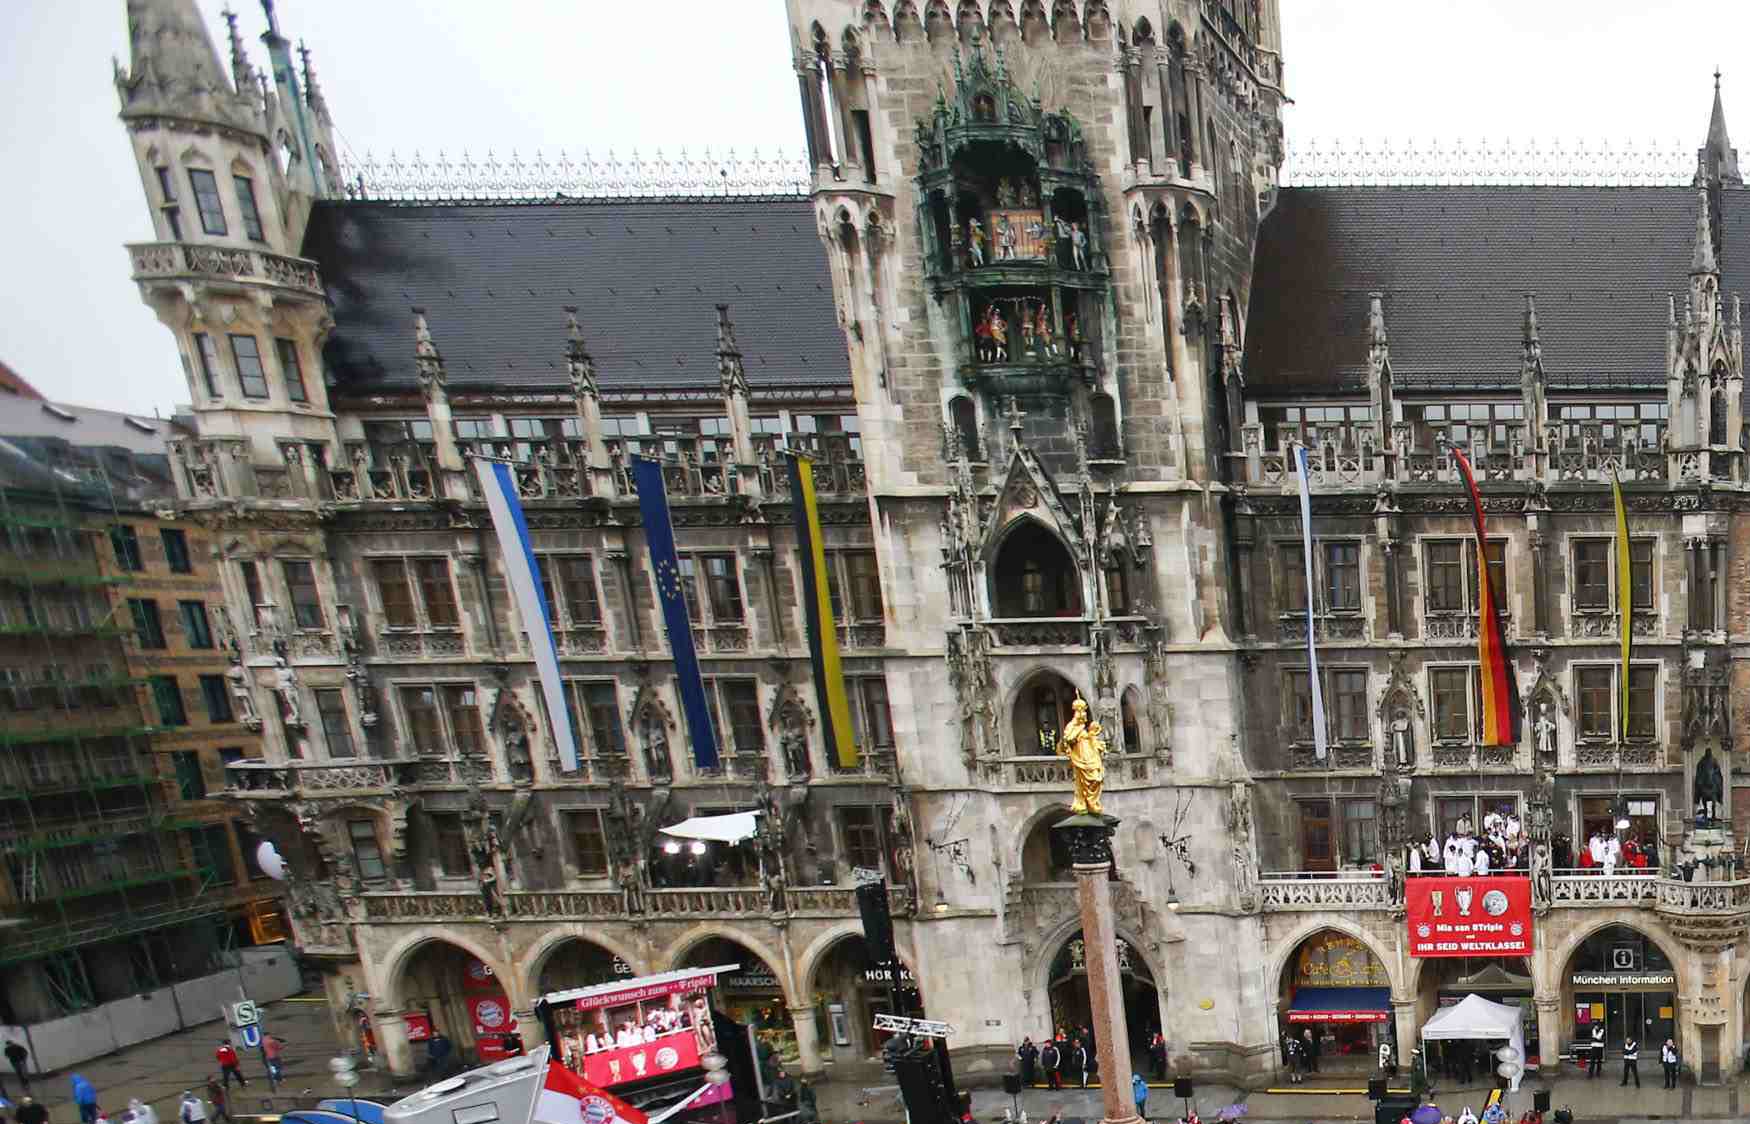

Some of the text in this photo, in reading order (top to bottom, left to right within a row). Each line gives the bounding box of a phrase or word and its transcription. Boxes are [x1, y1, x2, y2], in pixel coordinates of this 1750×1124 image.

[1417, 943, 1434, 951] IHR
[1460, 941, 1525, 951] WELTKLASSE!
[1573, 974, 1674, 984] München Information
[580, 987, 645, 1008] Glückwunsch
[647, 983, 668, 996] zum
